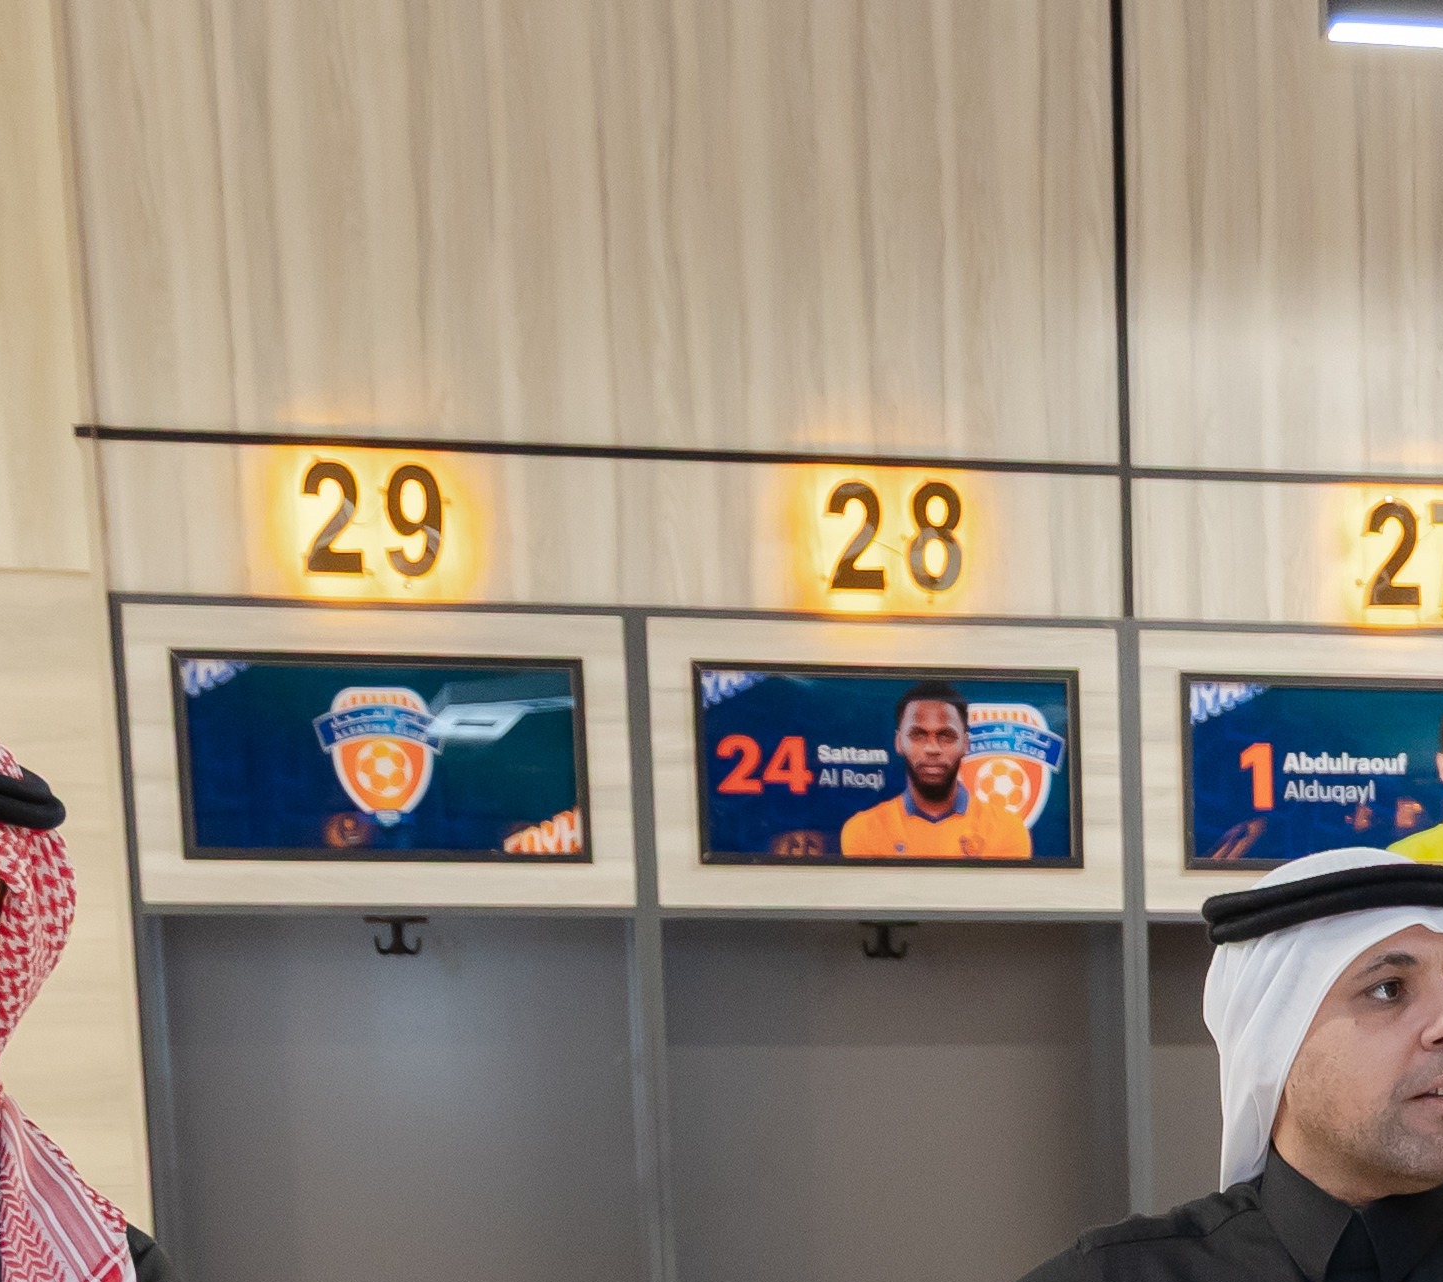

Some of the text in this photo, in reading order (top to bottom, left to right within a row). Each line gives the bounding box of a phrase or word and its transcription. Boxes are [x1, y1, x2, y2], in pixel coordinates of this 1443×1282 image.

[303, 461, 443, 578] 29
[825, 481, 962, 592] 28
[716, 733, 889, 795] 24 Sattam
[819, 769, 886, 791] Al Roqi
[1240, 743, 1408, 811] 1 Abdulraouf
[1284, 779, 1376, 806] Alduqayl
